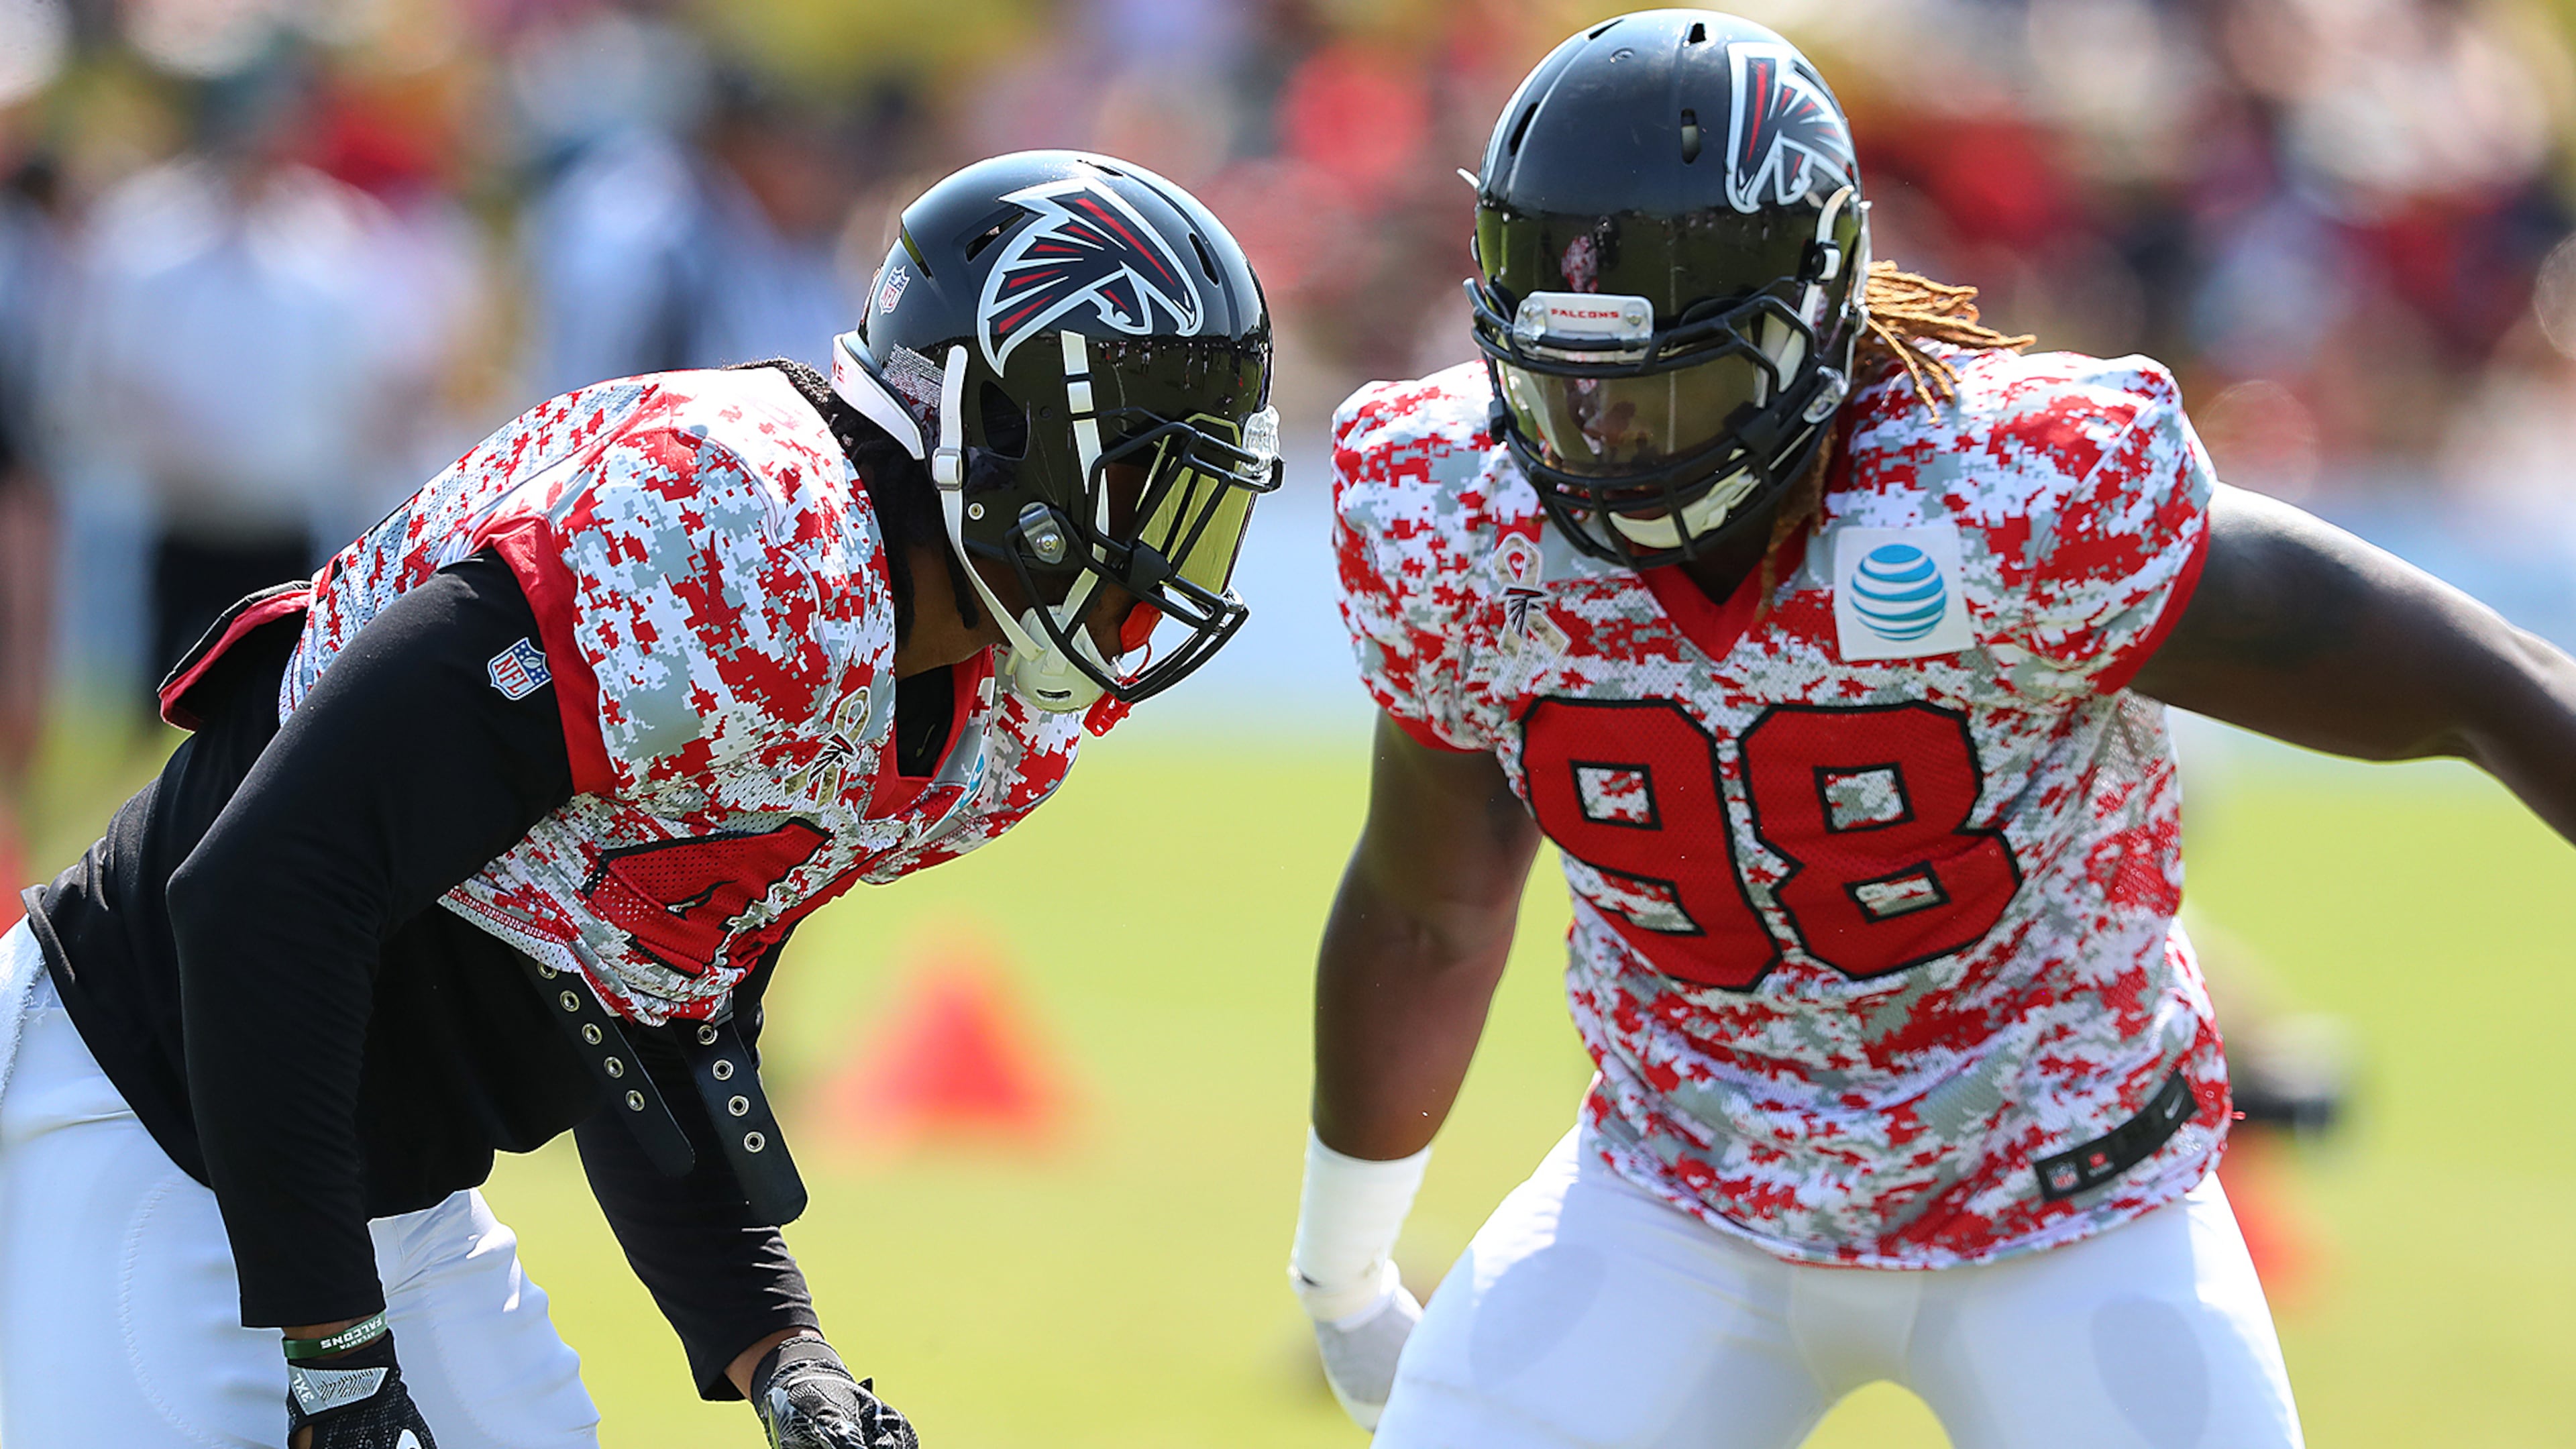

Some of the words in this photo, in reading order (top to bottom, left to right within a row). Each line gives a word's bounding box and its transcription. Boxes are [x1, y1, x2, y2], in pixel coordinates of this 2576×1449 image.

[1551, 309, 1619, 319] FALCONS
[494, 655, 529, 694] NFL
[1521, 696, 2023, 993] 98
[320, 1317, 382, 1349] FALCONS
[339, 1332, 376, 1350] ATLANTA
[292, 1373, 314, 1403] 3XL
